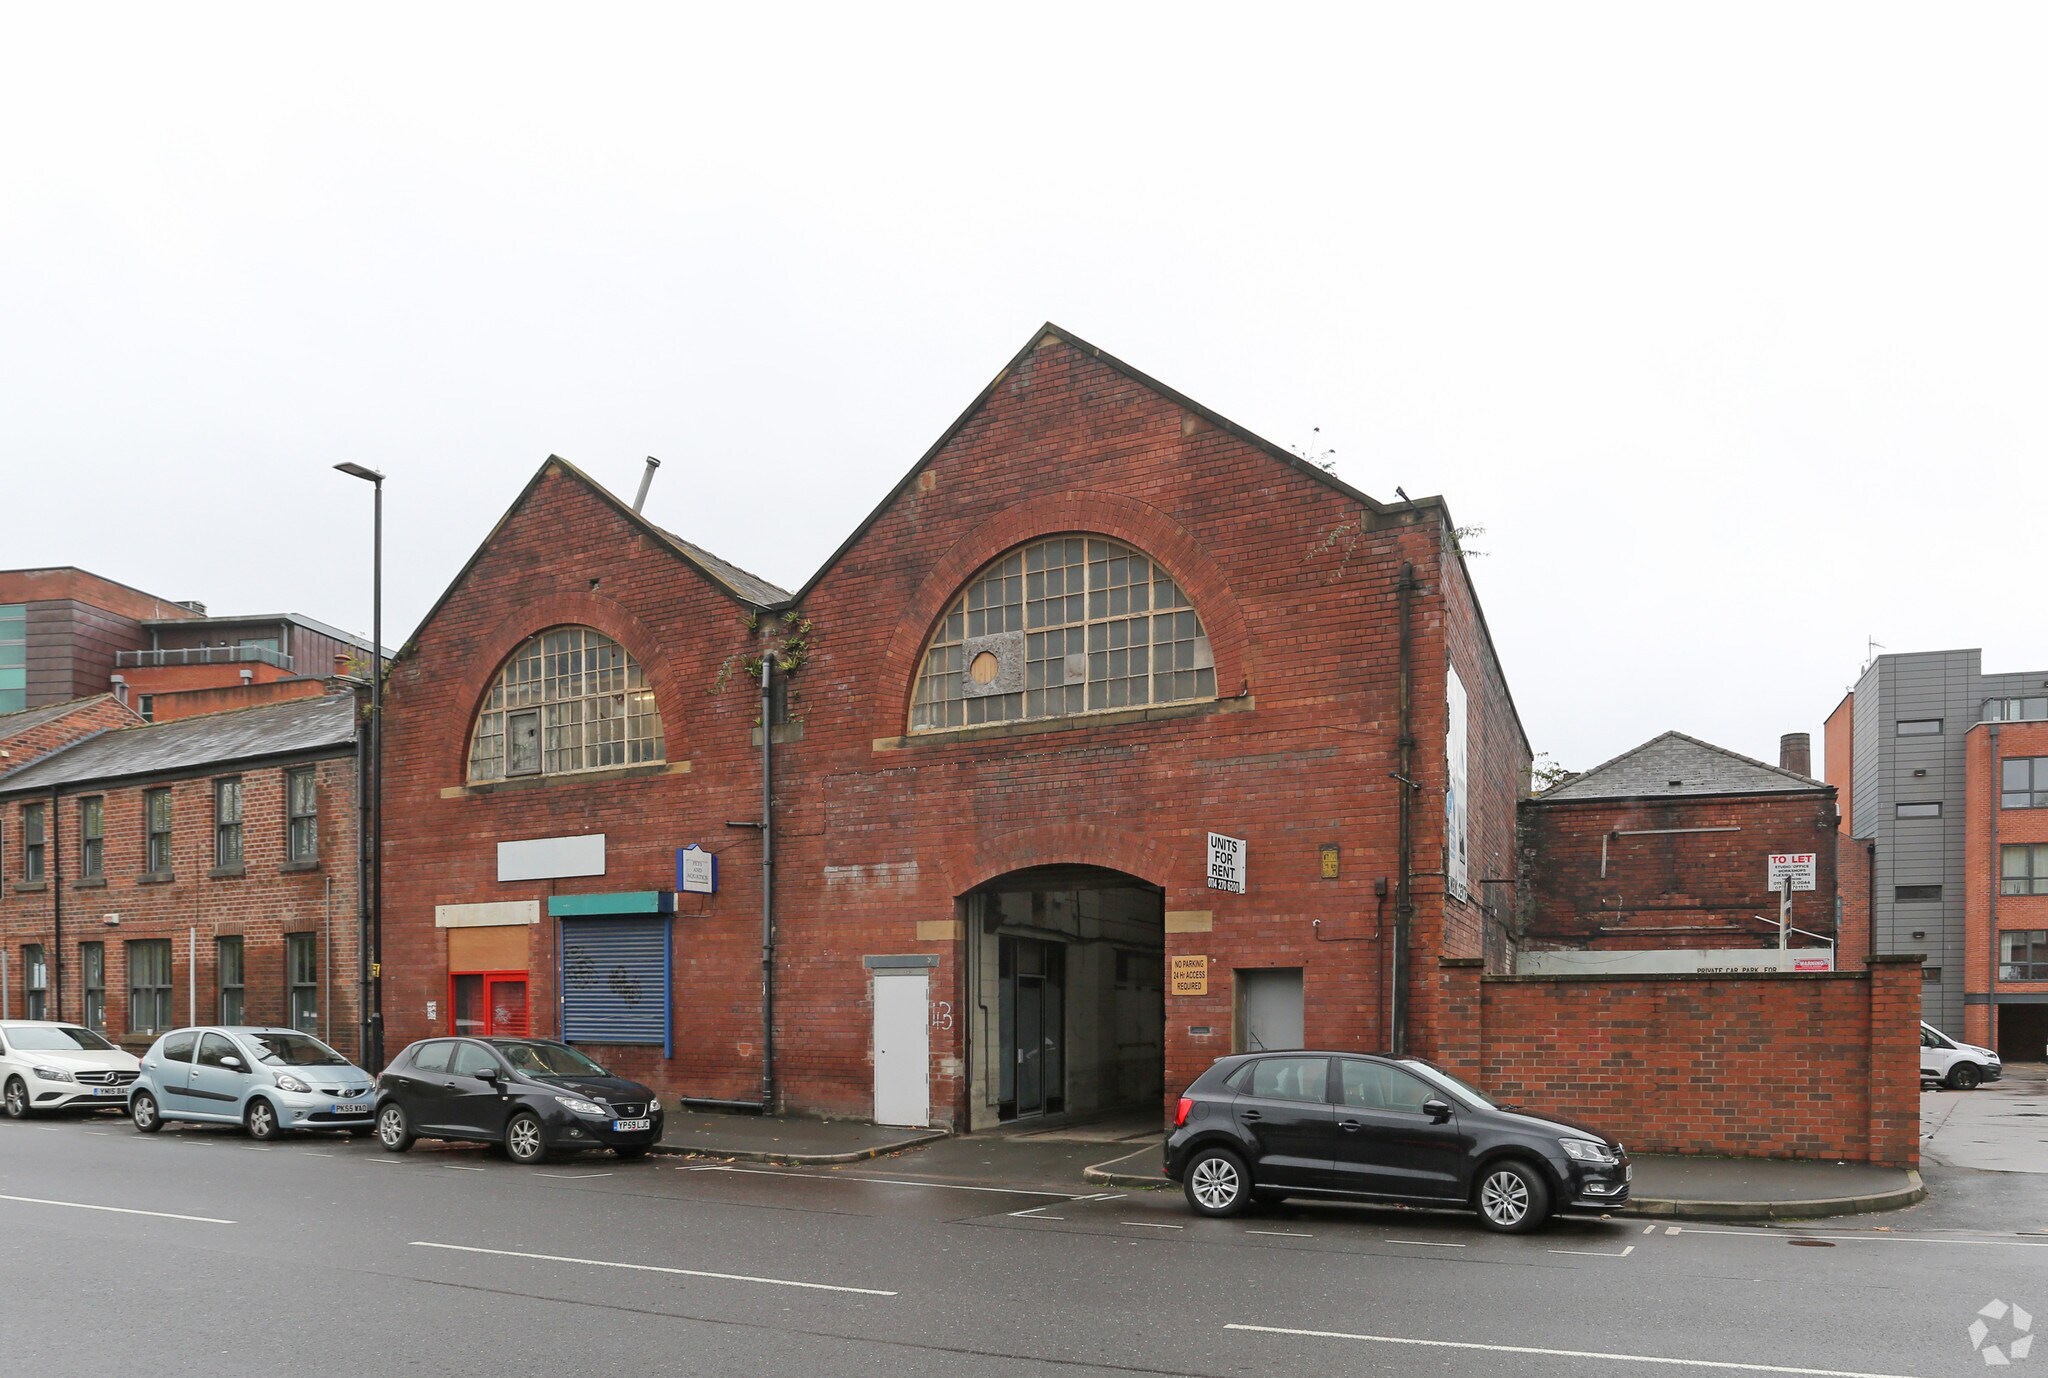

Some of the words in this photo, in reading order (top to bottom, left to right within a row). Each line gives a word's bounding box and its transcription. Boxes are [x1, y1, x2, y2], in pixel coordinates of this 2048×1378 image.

[1211, 836, 1237, 853] UNITS
[1215, 851, 1233, 866] FOR
[1771, 856, 1787, 864] TO
[1792, 855, 1812, 863] LET
[1212, 864, 1235, 879] RENT
[1175, 960, 1182, 968] NO
[1183, 959, 1204, 968] PARKING
[1173, 971, 1179, 979] 24
[1186, 970, 1205, 979] ACCESS
[1177, 981, 1201, 990] REQUIRED
[336, 1104, 353, 1112] PK55
[618, 1121, 636, 1129] YP59
[637, 1120, 649, 1128] LJC
